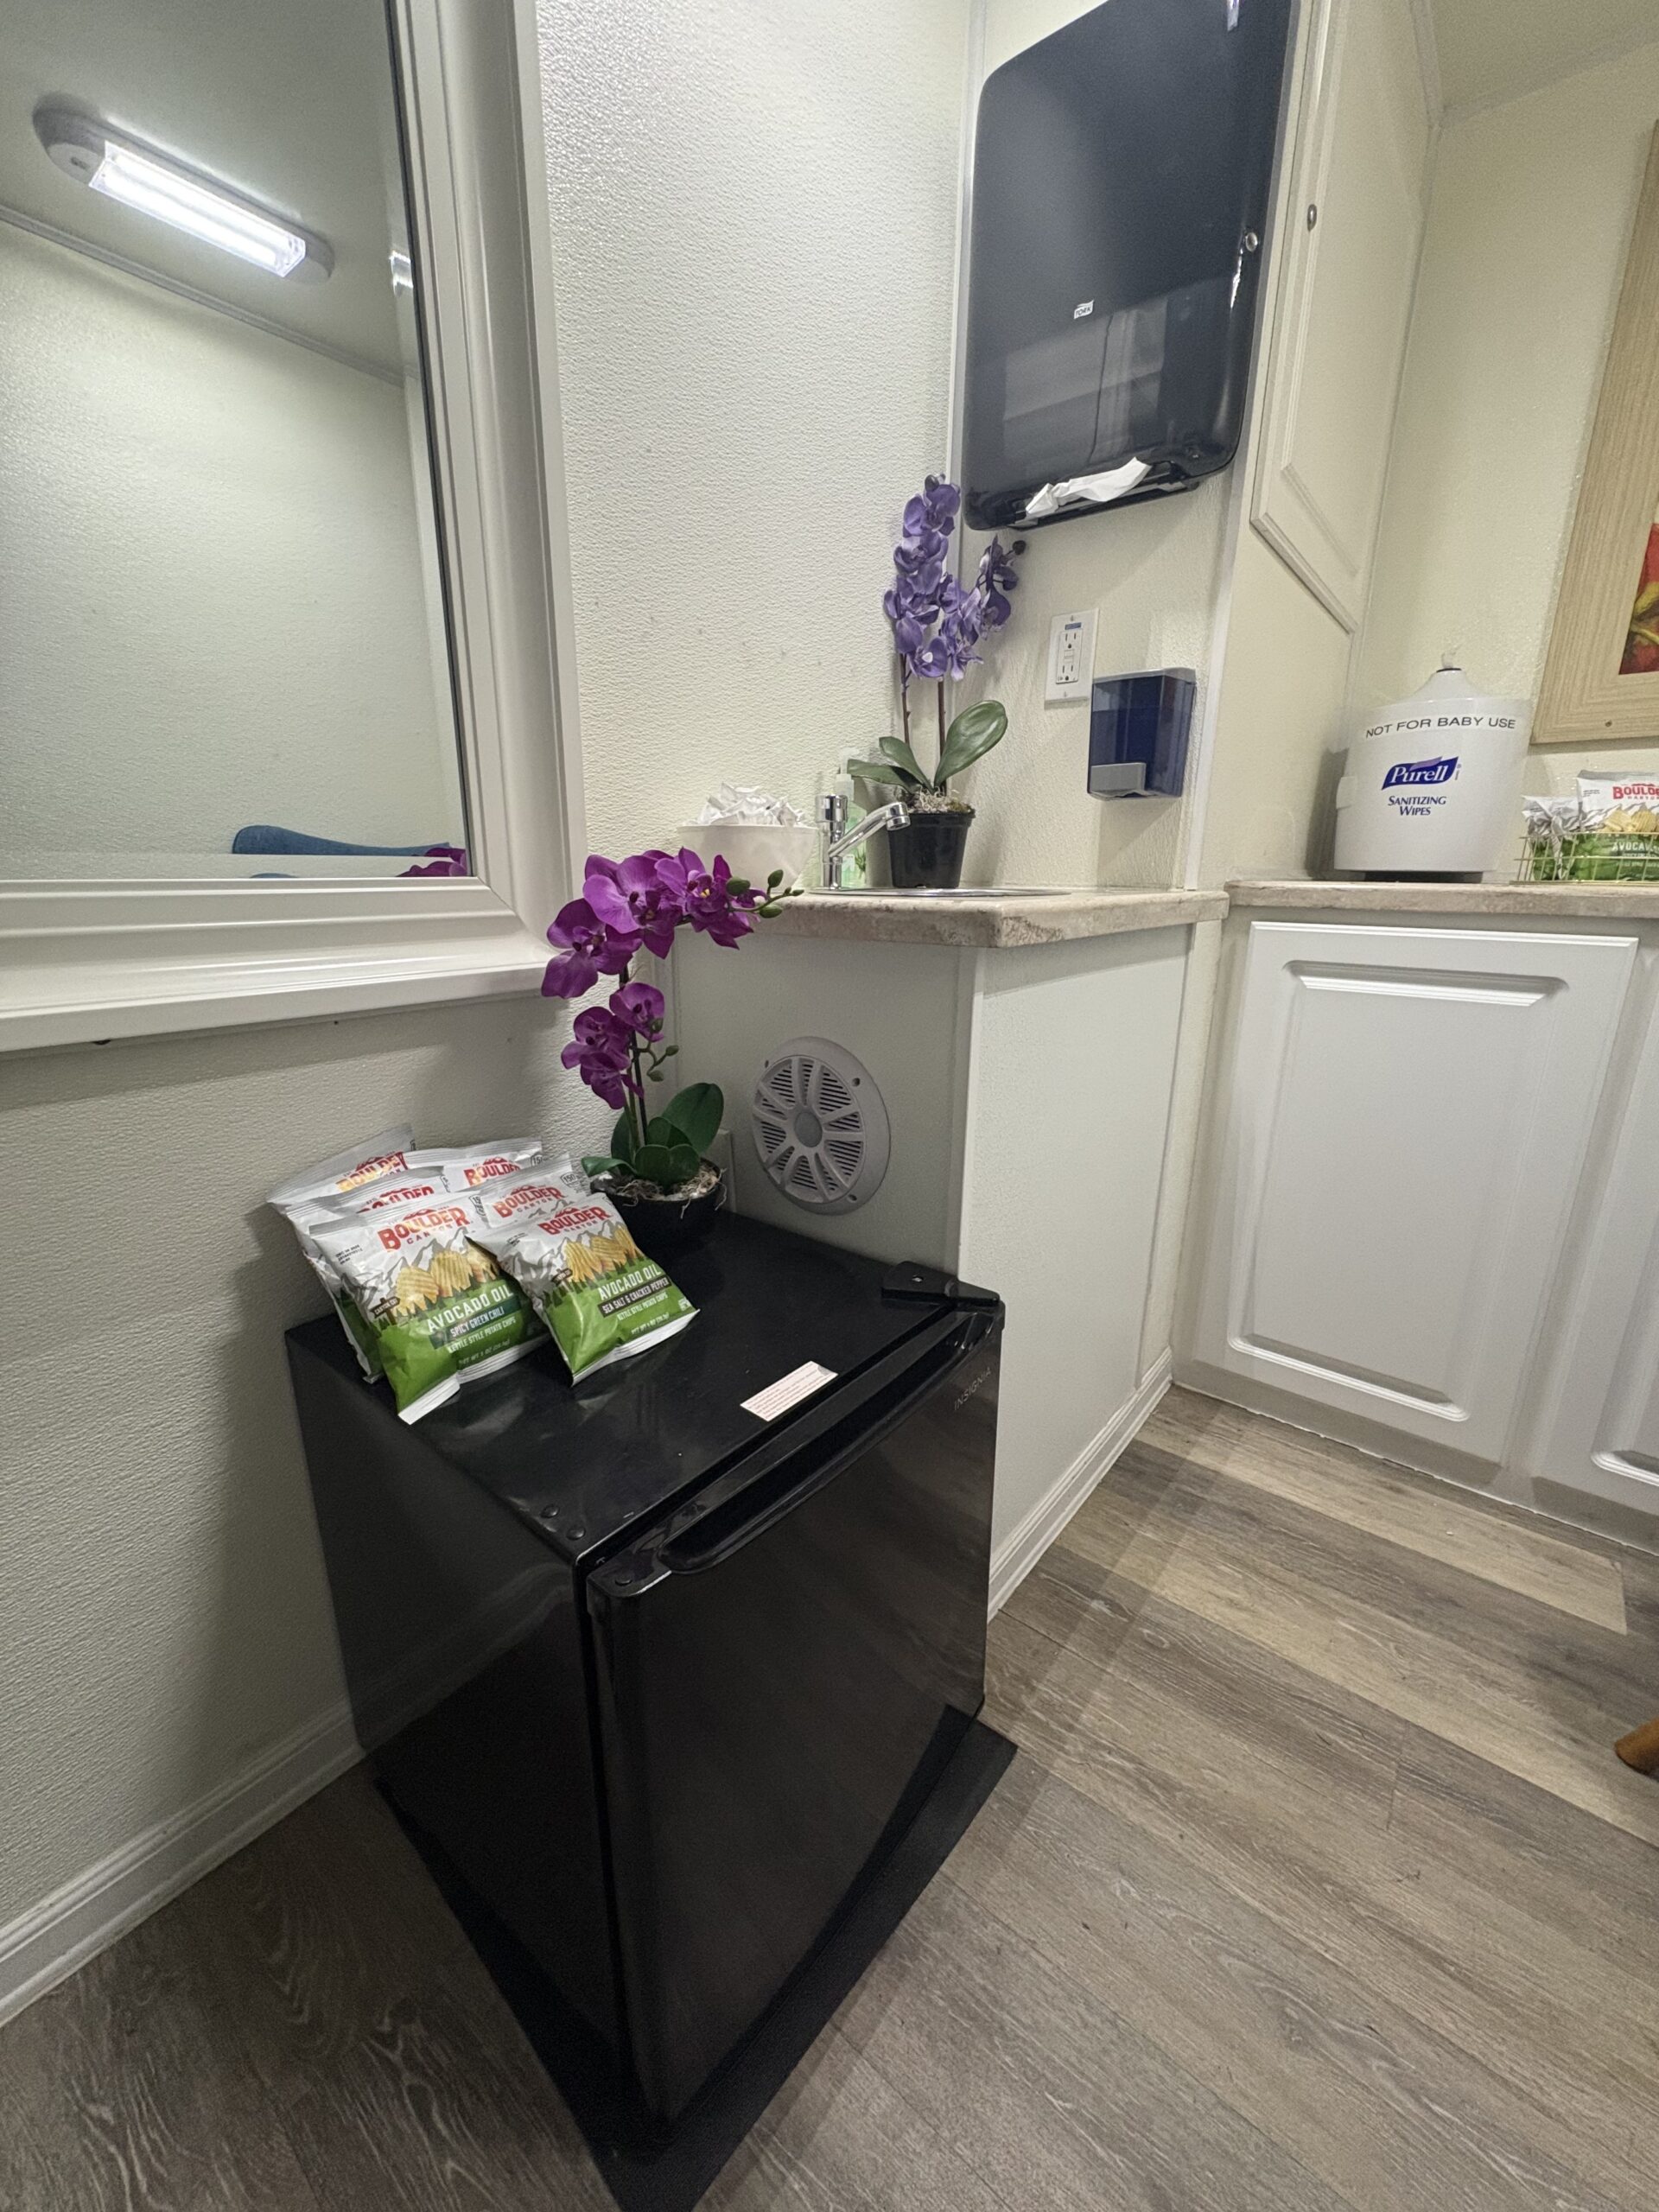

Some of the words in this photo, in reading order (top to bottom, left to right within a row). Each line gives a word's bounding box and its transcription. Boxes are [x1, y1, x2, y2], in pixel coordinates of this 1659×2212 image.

[1075, 306, 1092, 318] TORK
[1365, 724, 1393, 738] NOT
[1396, 718, 1432, 731] FOR
[1437, 716, 1484, 727] BABY
[1488, 718, 1516, 729] USE
[1389, 765, 1449, 784] Purell
[1388, 796, 1447, 806] SANITIZING
[1399, 805, 1431, 816] WIPES
[493, 1186, 566, 1217] BOULDER
[378, 1207, 470, 1250] BOULDER
[537, 1206, 611, 1236] BOULDER
[598, 1271, 644, 1301] AVOCADO
[643, 1263, 662, 1280] OIL
[602, 1303, 614, 1313] SEA
[613, 1297, 626, 1309] SALT
[630, 1285, 652, 1301] CRACKED
[651, 1277, 670, 1292] PEPPER
[427, 1293, 492, 1334] AVOCADO
[491, 1284, 514, 1302] OIL
[450, 1322, 470, 1338] SPICY
[469, 1313, 490, 1329] GREEN
[488, 1306, 505, 1319] CHILI
[468, 1332, 485, 1344] STYLE
[484, 1322, 503, 1338] POTATO
[502, 1316, 517, 1328] CHIPS
[954, 1366, 992, 1411] INSIGNIA
